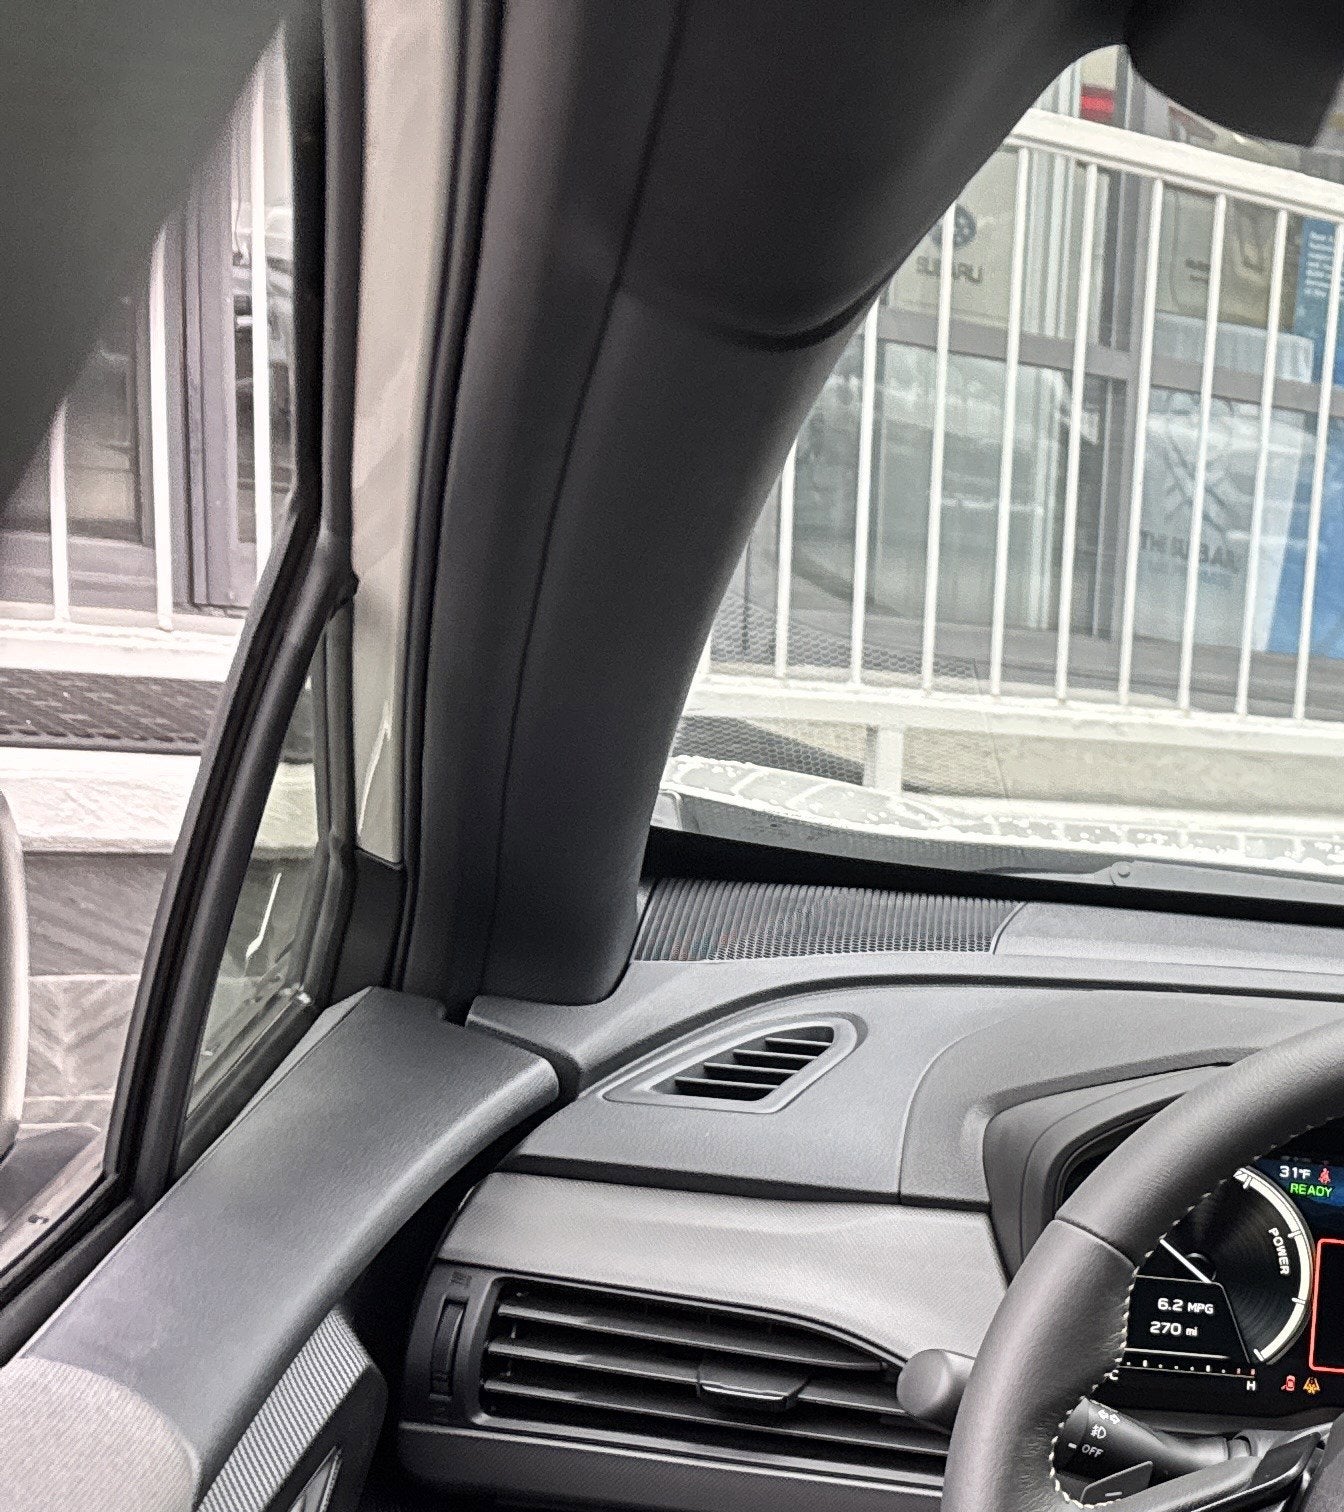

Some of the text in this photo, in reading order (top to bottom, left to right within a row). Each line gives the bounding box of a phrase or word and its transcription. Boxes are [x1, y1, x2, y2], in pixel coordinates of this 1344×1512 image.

[916, 256, 984, 284] SUARU
[1290, 1183, 1333, 1197] READY
[1268, 1227, 1290, 1275] POWER
[1157, 1298, 1214, 1314] 6.2 MPG
[1150, 1321, 1181, 1336] 270
[1246, 1381, 1256, 1391] H
[1082, 1443, 1104, 1458] OFF
